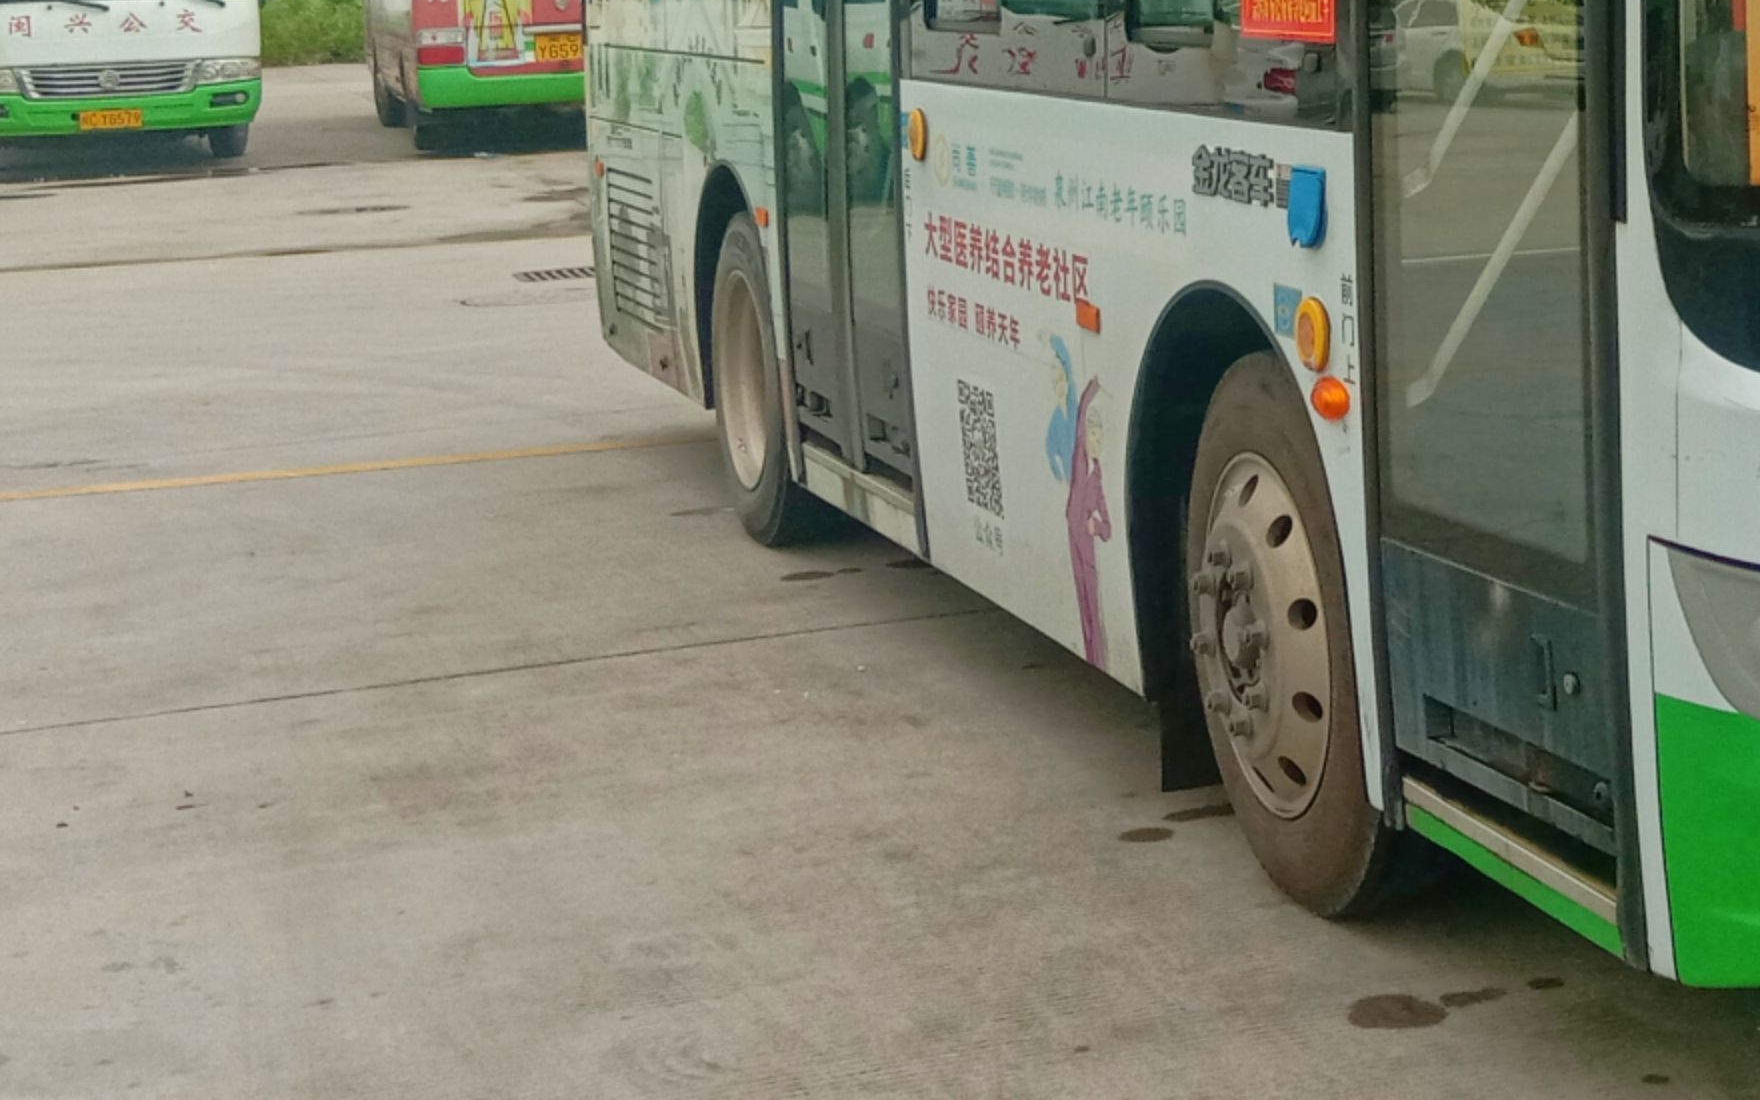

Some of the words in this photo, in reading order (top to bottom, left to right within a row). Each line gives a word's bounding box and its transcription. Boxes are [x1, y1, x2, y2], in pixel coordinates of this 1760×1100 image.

[1192, 144, 1275, 208] 金龙客车
[924, 211, 1089, 305] 大型医养结合养老社区
[927, 285, 968, 330] 快乐家园
[975, 302, 1020, 350] 颐养天年
